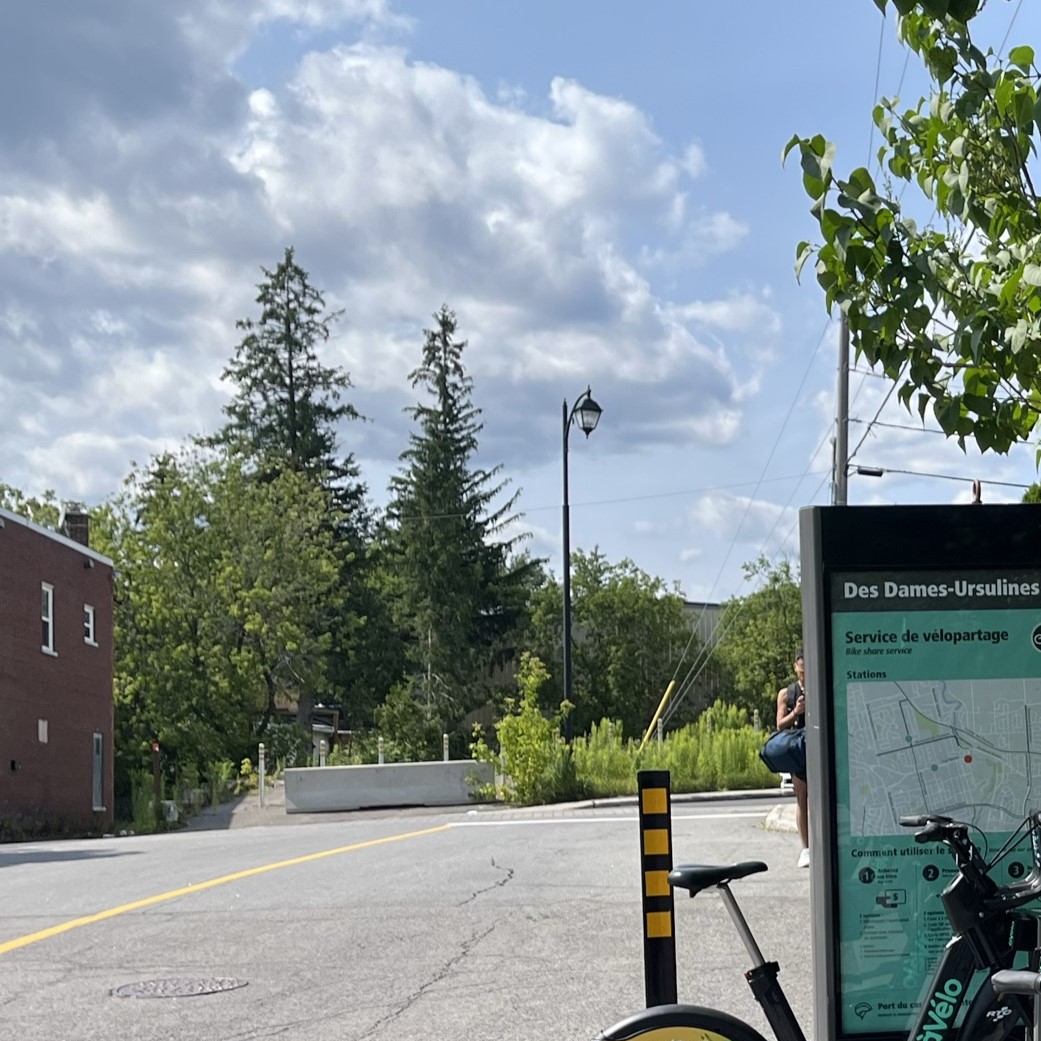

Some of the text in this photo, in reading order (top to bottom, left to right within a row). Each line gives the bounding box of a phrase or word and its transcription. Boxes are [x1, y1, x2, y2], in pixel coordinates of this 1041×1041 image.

[844, 581, 879, 598] Des
[884, 579, 1040, 598] Dames-Ursulines
[845, 628, 1009, 645] Service de vélopartage
[845, 646, 913, 655] Bike share service
[846, 670, 887, 680] Stations
[851, 848, 898, 858] Comment
[900, 846, 934, 857] utiliser
[936, 846, 946, 856] le
[878, 1002, 896, 1010] Port
[897, 1001, 908, 1009] du
